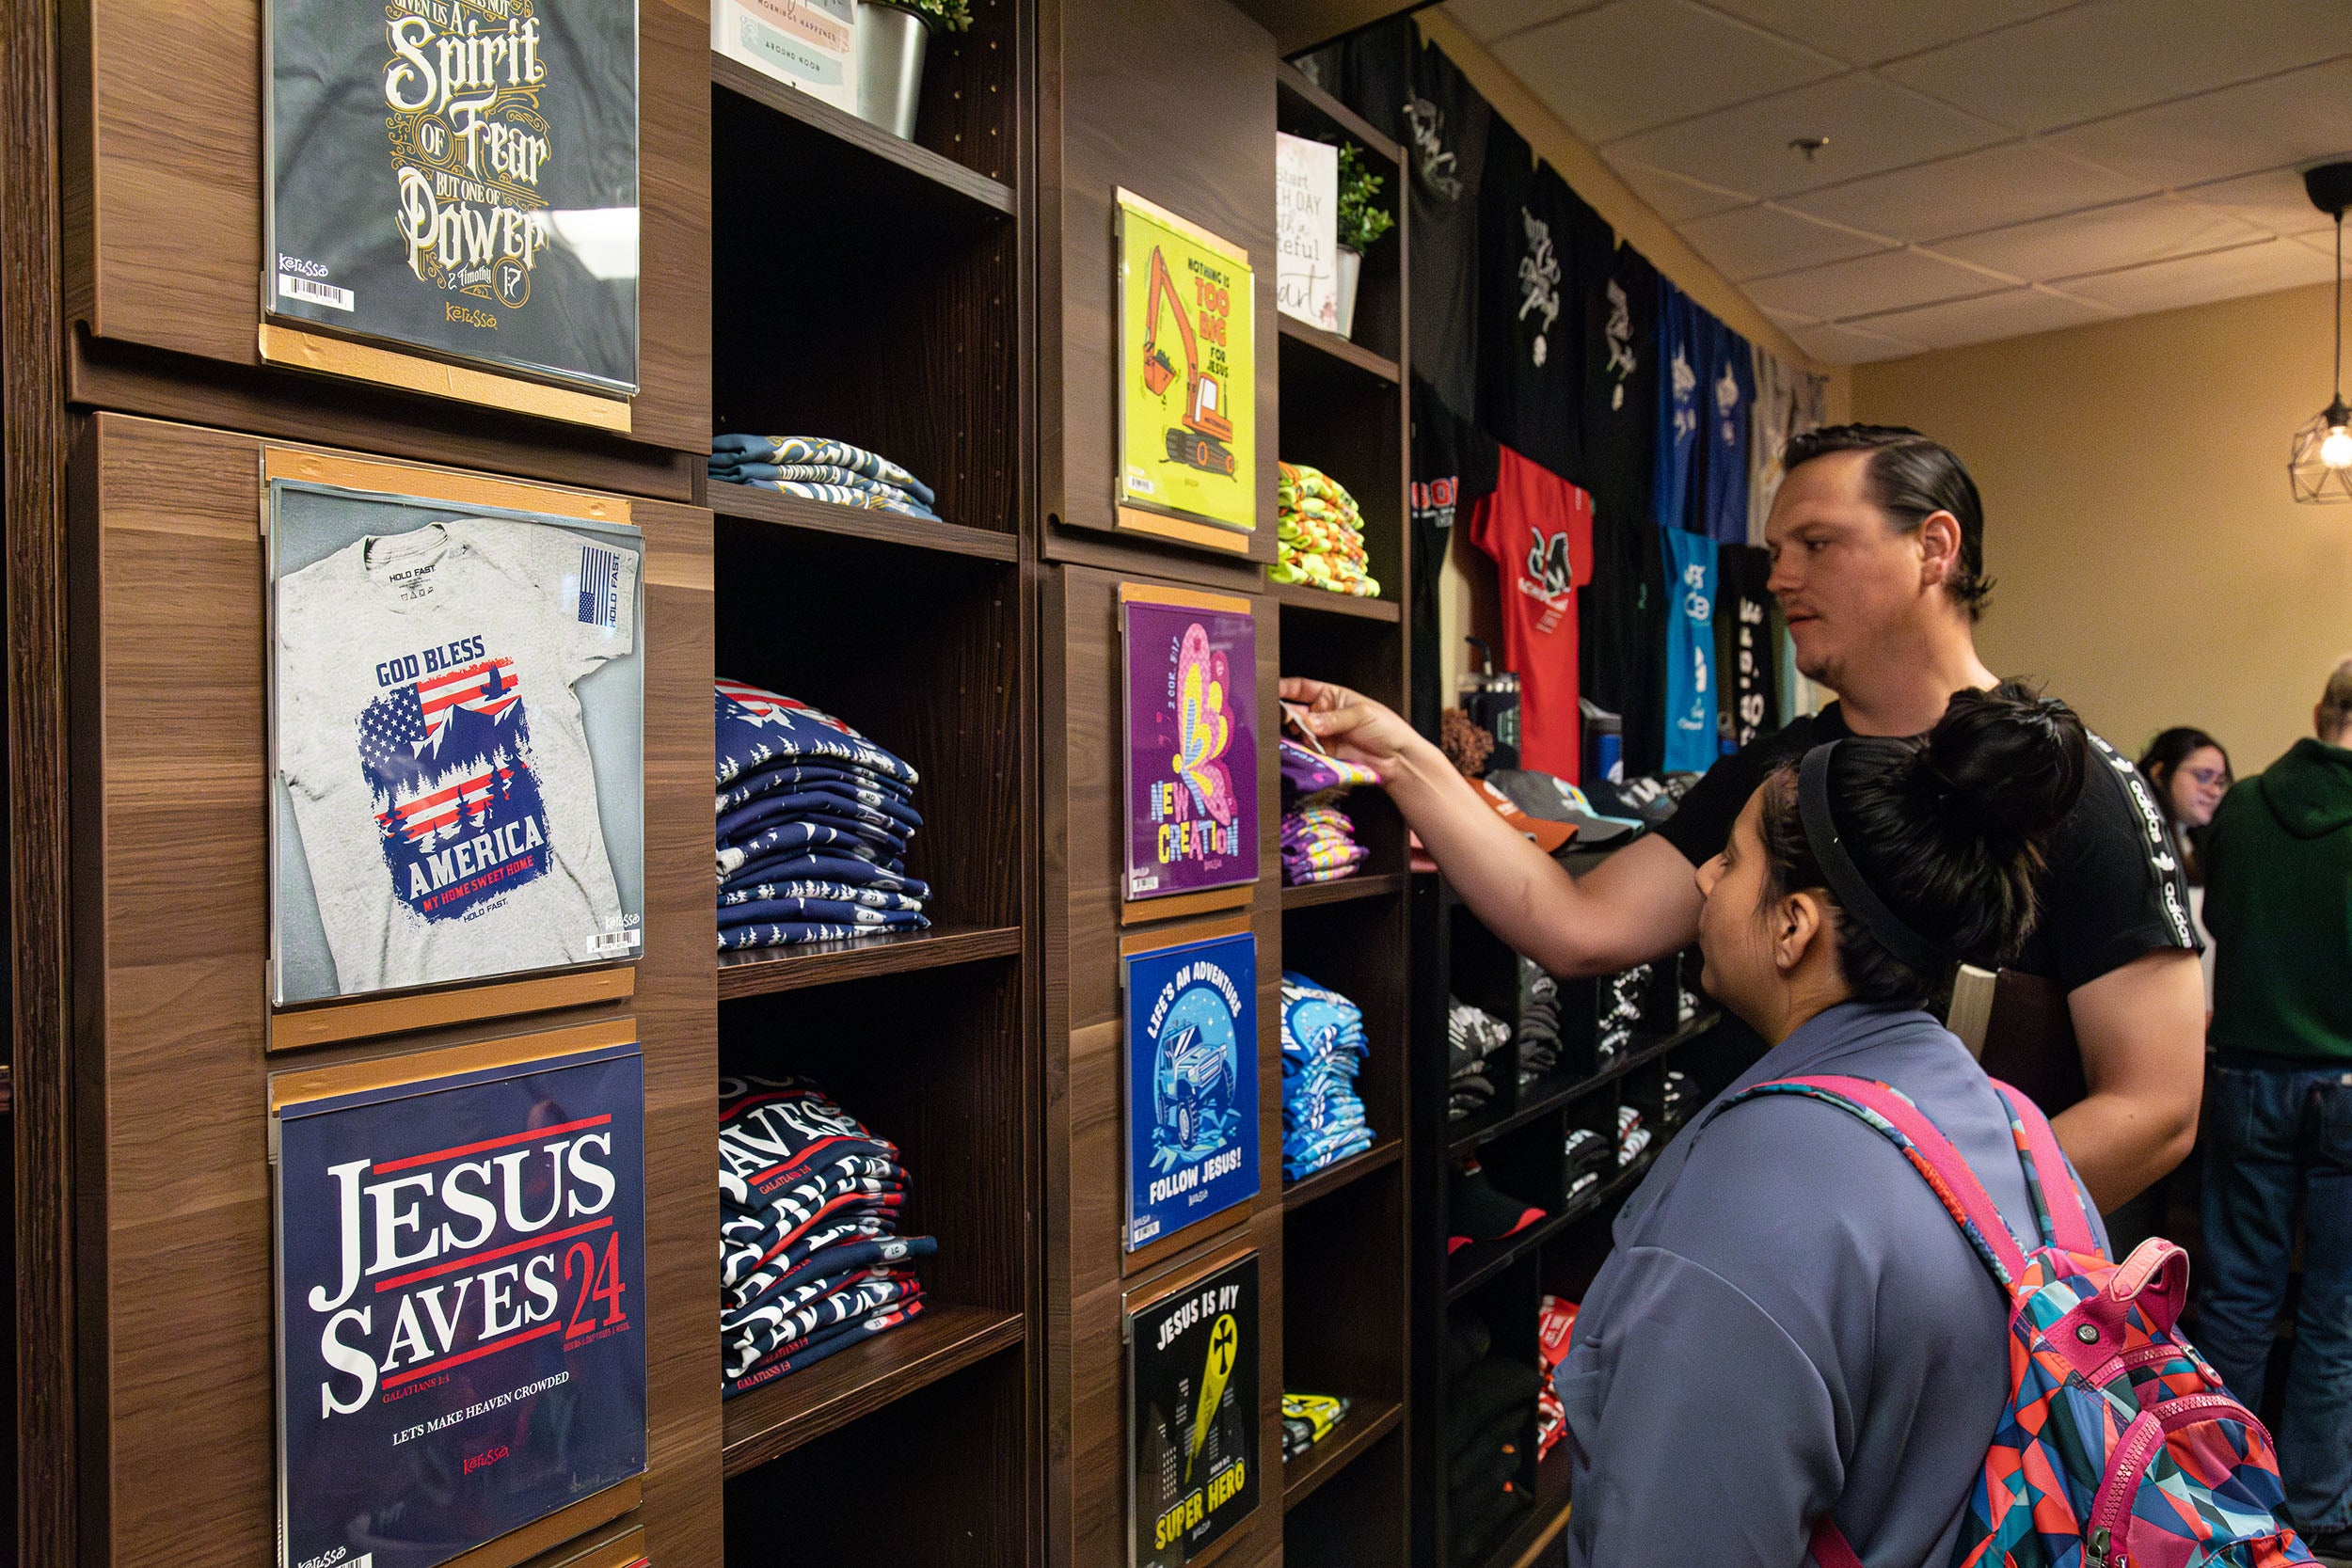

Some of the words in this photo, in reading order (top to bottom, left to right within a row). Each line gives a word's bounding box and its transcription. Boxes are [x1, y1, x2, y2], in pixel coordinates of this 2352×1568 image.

[432, 2, 449, 25] US
[449, 0, 466, 37] A
[385, 15, 546, 116] Spirit
[421, 123, 446, 156] OF
[449, 84, 548, 186] Fear
[436, 170, 460, 198] BUT
[461, 180, 485, 203] ONE
[486, 188, 501, 206] OF
[1295, 191, 1322, 216] DAY
[448, 272, 458, 291] 2
[457, 263, 492, 286] Timothy
[1187, 257, 1221, 285] NOTHING
[1194, 276, 1231, 318] TOO
[1199, 309, 1228, 348] BIG
[1210, 346, 1226, 364] FOR
[389, 570, 412, 582] HOLD
[414, 563, 436, 576] FAST
[612, 552, 621, 589] FAST
[609, 593, 618, 629] HOLD
[375, 658, 421, 688] GOD
[422, 634, 485, 673] BLESS
[1151, 780, 1189, 823] NEW
[2130, 780, 2163, 844] adidas
[407, 815, 546, 900] AMERICA
[1158, 817, 1239, 864] CREATION
[422, 895, 439, 912] MY
[440, 882, 470, 904] HOME
[470, 868, 505, 892] SWEET
[506, 855, 534, 877] HOME
[463, 909, 485, 923] HOLD
[486, 898, 507, 912] FAST
[2164, 881, 2193, 949] adidas
[1147, 982, 1175, 1039] LIFE'S
[1176, 965, 1191, 991] AN
[1192, 960, 1242, 1019] ADVENTURE
[1150, 1164, 1200, 1205] FOLLOW
[1201, 1146, 1242, 1183] JESUS!
[308, 1132, 616, 1312] JESUS
[321, 1252, 559, 1418] SAVES
[564, 1230, 627, 1340] 24
[1156, 1298, 1200, 1351] JESUS
[1201, 1290, 1216, 1318] IS
[1218, 1285, 1240, 1311] MY
[382, 1378, 437, 1404] GALATIANS
[737, 1365, 781, 1390] GALATIANS
[392, 1424, 424, 1446] LETS
[426, 1410, 464, 1433] MAKE
[465, 1391, 514, 1420] HEAVEN
[514, 1370, 570, 1402] CROWDED
[1154, 1491, 1204, 1551] SUPER
[1207, 1460, 1246, 1513] HERO
